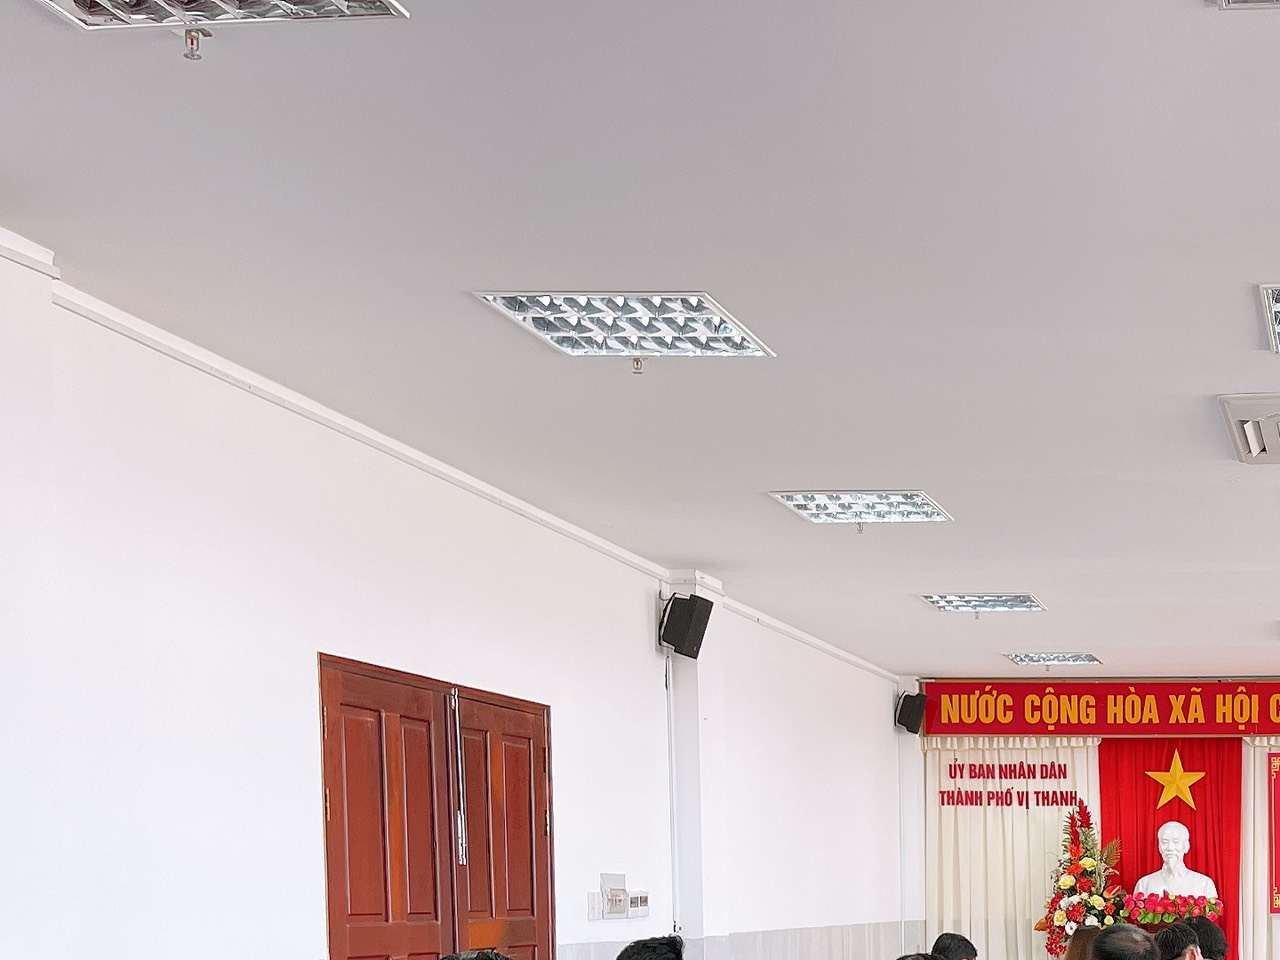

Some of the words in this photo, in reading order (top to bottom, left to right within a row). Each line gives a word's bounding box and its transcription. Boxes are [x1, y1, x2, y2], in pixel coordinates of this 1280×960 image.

[941, 685, 1013, 724] NƯỚC
[1024, 687, 1096, 730] CỘNG
[1107, 687, 1160, 724] HÒA
[1168, 687, 1205, 724] XÃ
[1216, 686, 1259, 730] HỘI
[948, 758, 965, 779] ỦY
[969, 764, 996, 779] BAN
[999, 761, 1036, 779] NHÂN
[1040, 761, 1067, 779] DÂN
[939, 787, 983, 806] THÀNH
[987, 786, 1014, 806] PHỐ
[1017, 791, 1030, 809] VỊ
[1034, 791, 1077, 806] THANH
